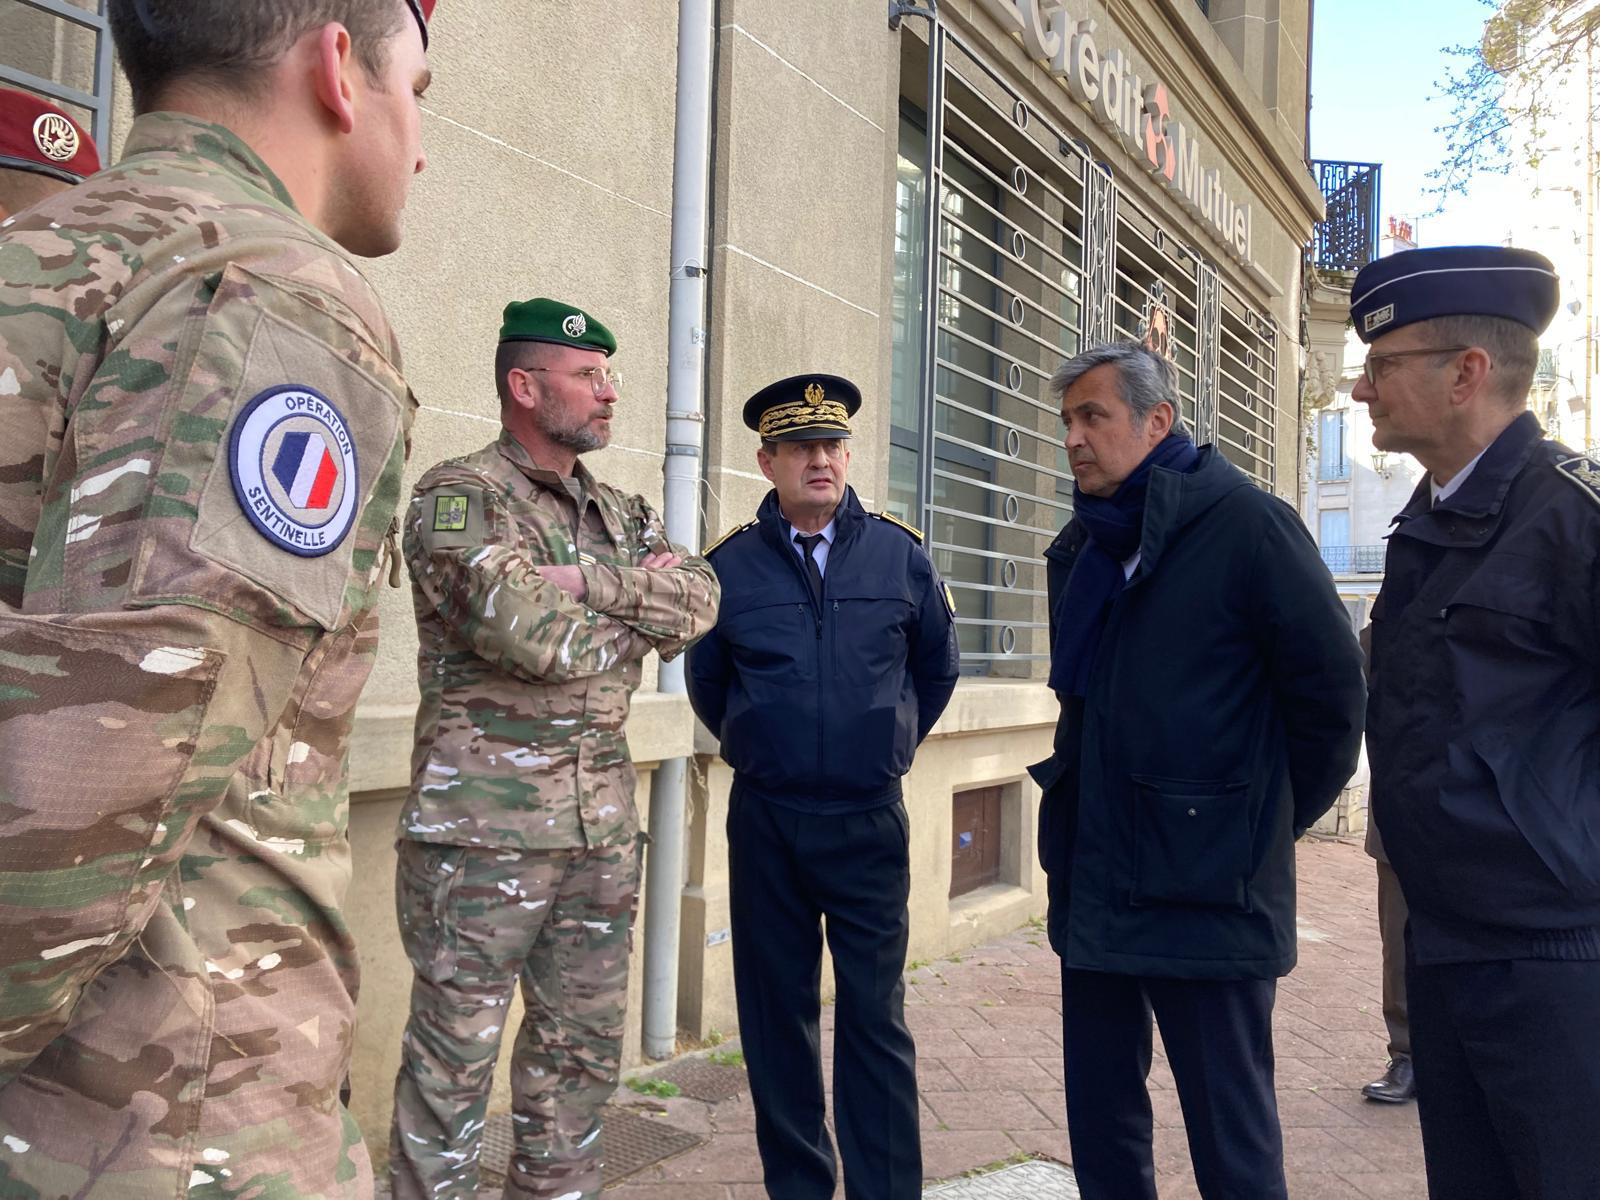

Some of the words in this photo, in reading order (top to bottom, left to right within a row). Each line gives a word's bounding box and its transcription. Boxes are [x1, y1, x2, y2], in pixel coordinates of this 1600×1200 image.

[1022, 0, 1146, 151] Crédit
[1178, 122, 1252, 262] Mutuel
[285, 396, 352, 455] OPÉRATION
[248, 486, 326, 547] SENTINELLE
